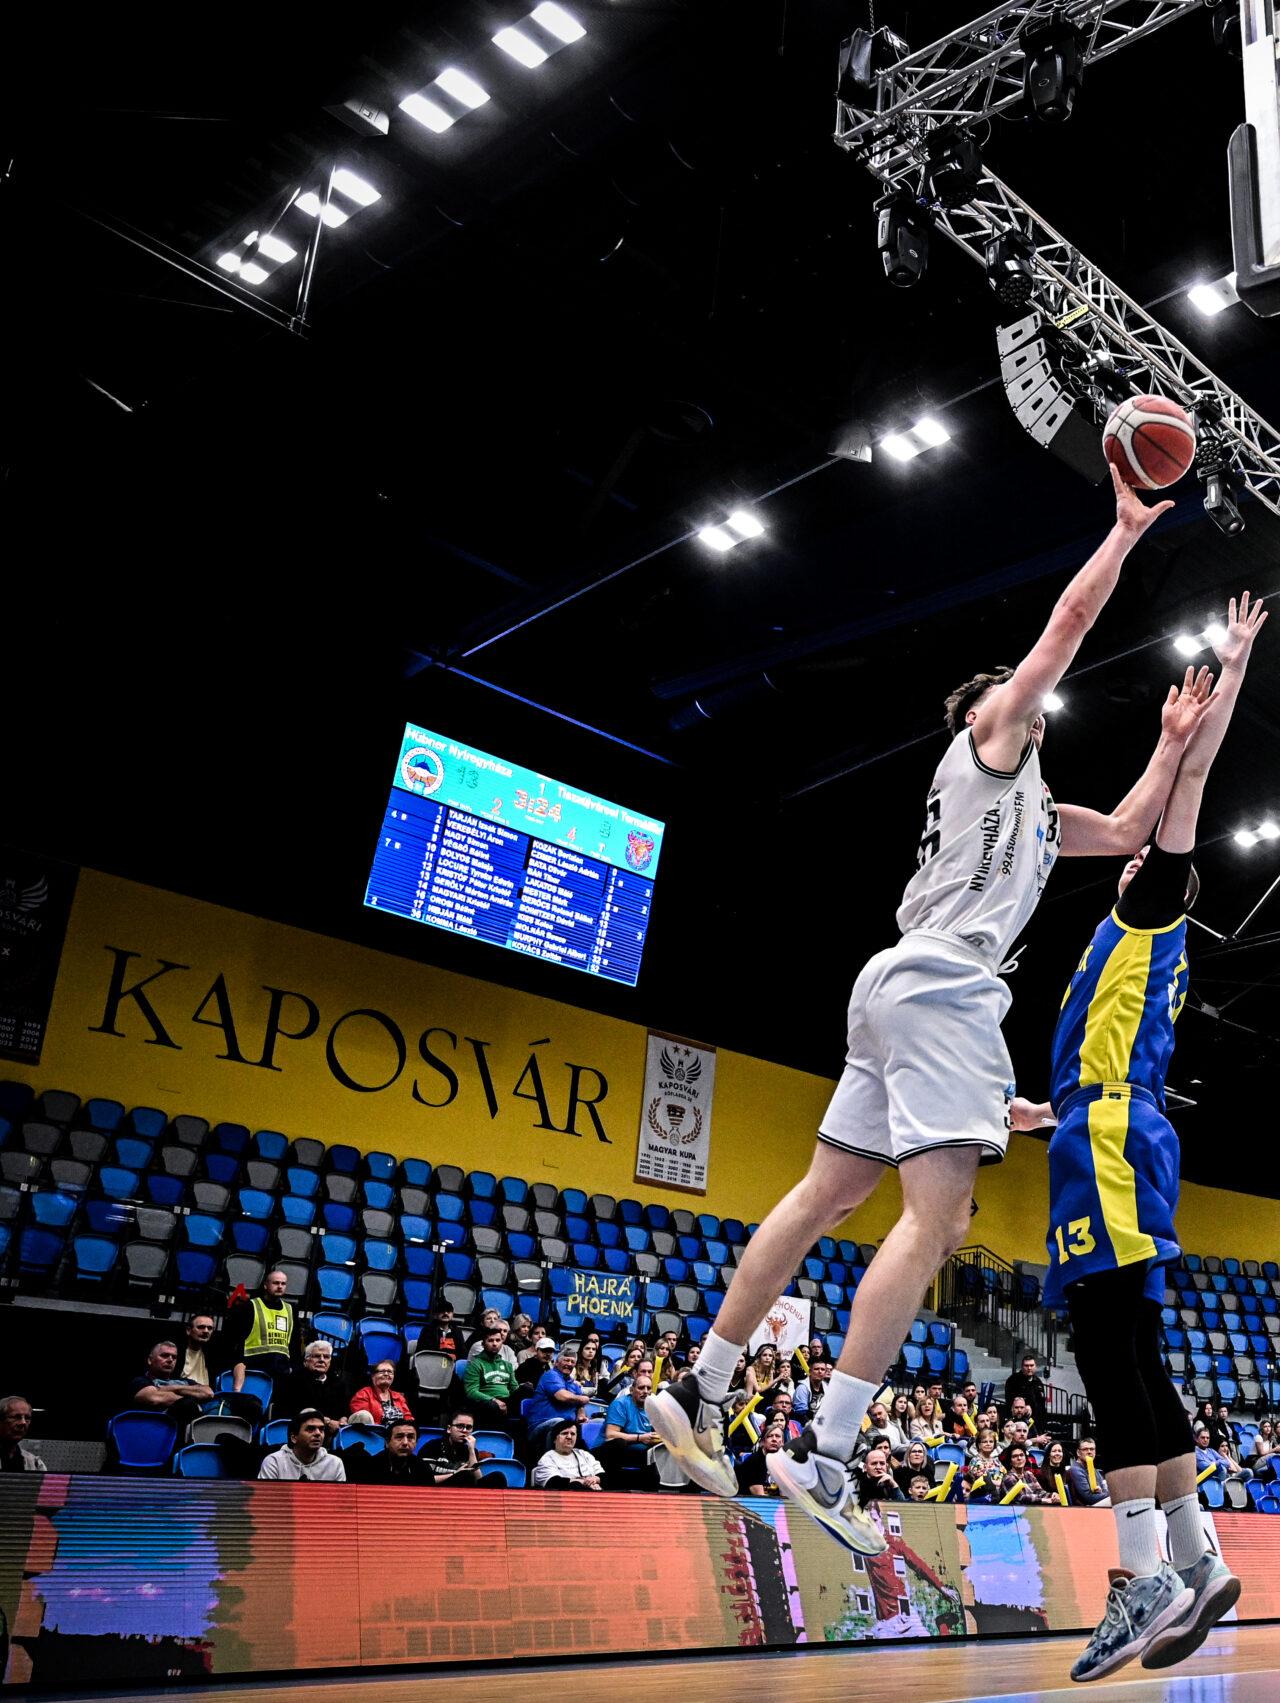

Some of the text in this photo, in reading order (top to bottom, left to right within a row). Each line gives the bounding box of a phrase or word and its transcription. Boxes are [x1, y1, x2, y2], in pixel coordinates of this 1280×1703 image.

[513, 788, 562, 823] 3:24
[88, 946, 613, 1144] KAPOSVÁR
[648, 1144, 696, 1161] MAGYAR KUPA
[1055, 1215, 1096, 1265] 13
[574, 1273, 633, 1296] HAJRÁ
[567, 1294, 634, 1318] PHOENIX
